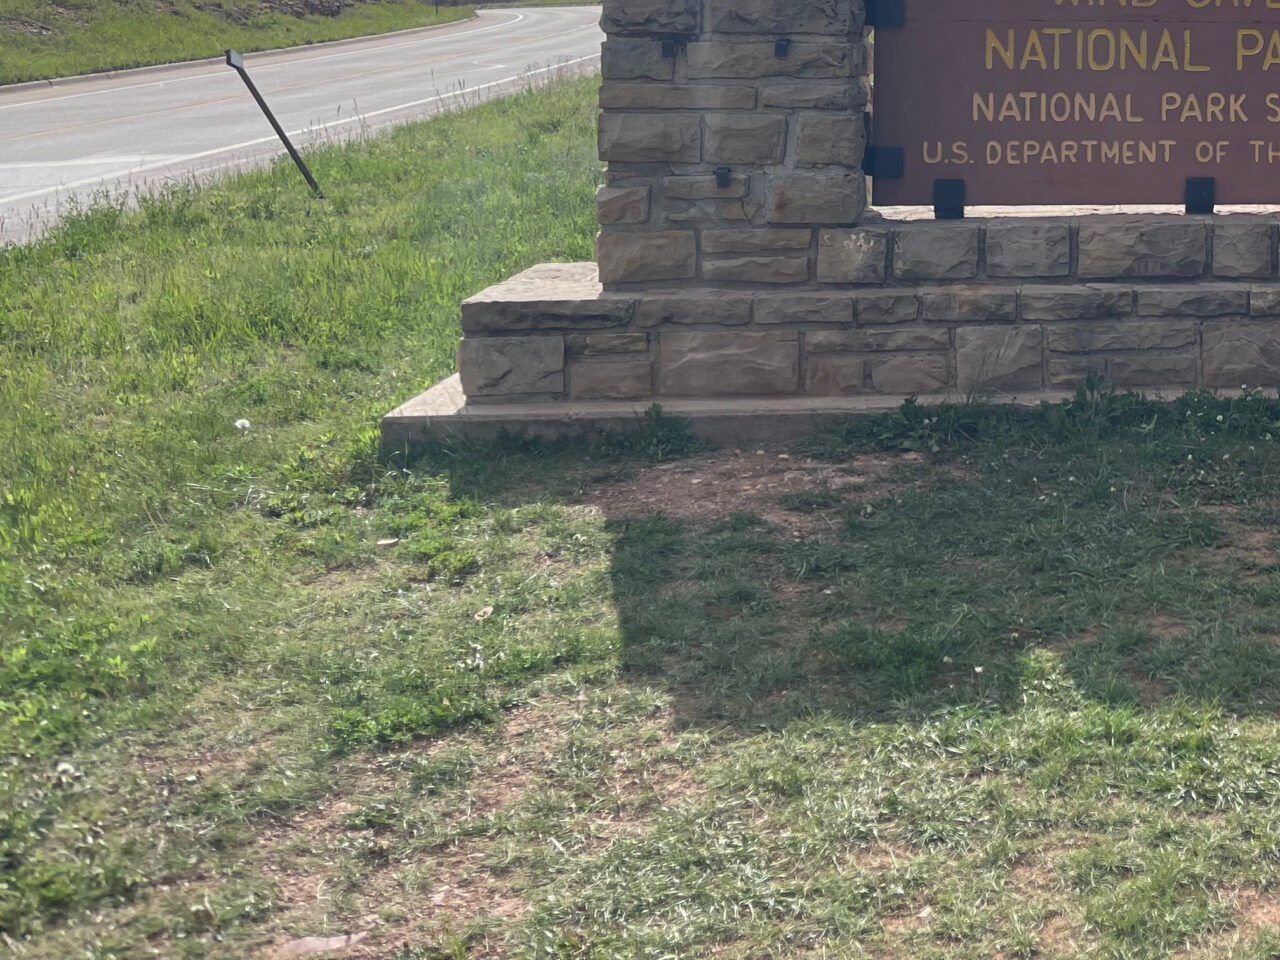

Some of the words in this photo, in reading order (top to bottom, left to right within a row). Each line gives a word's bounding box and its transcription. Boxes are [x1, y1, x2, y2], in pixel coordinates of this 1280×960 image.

[985, 28, 1210, 71] NATIONAL
[972, 92, 1144, 122] NATIONAL
[1161, 92, 1249, 122] PARK
[922, 141, 974, 164] U.S.
[986, 141, 1177, 165] DEPARTMENT
[1195, 141, 1230, 164] OF
